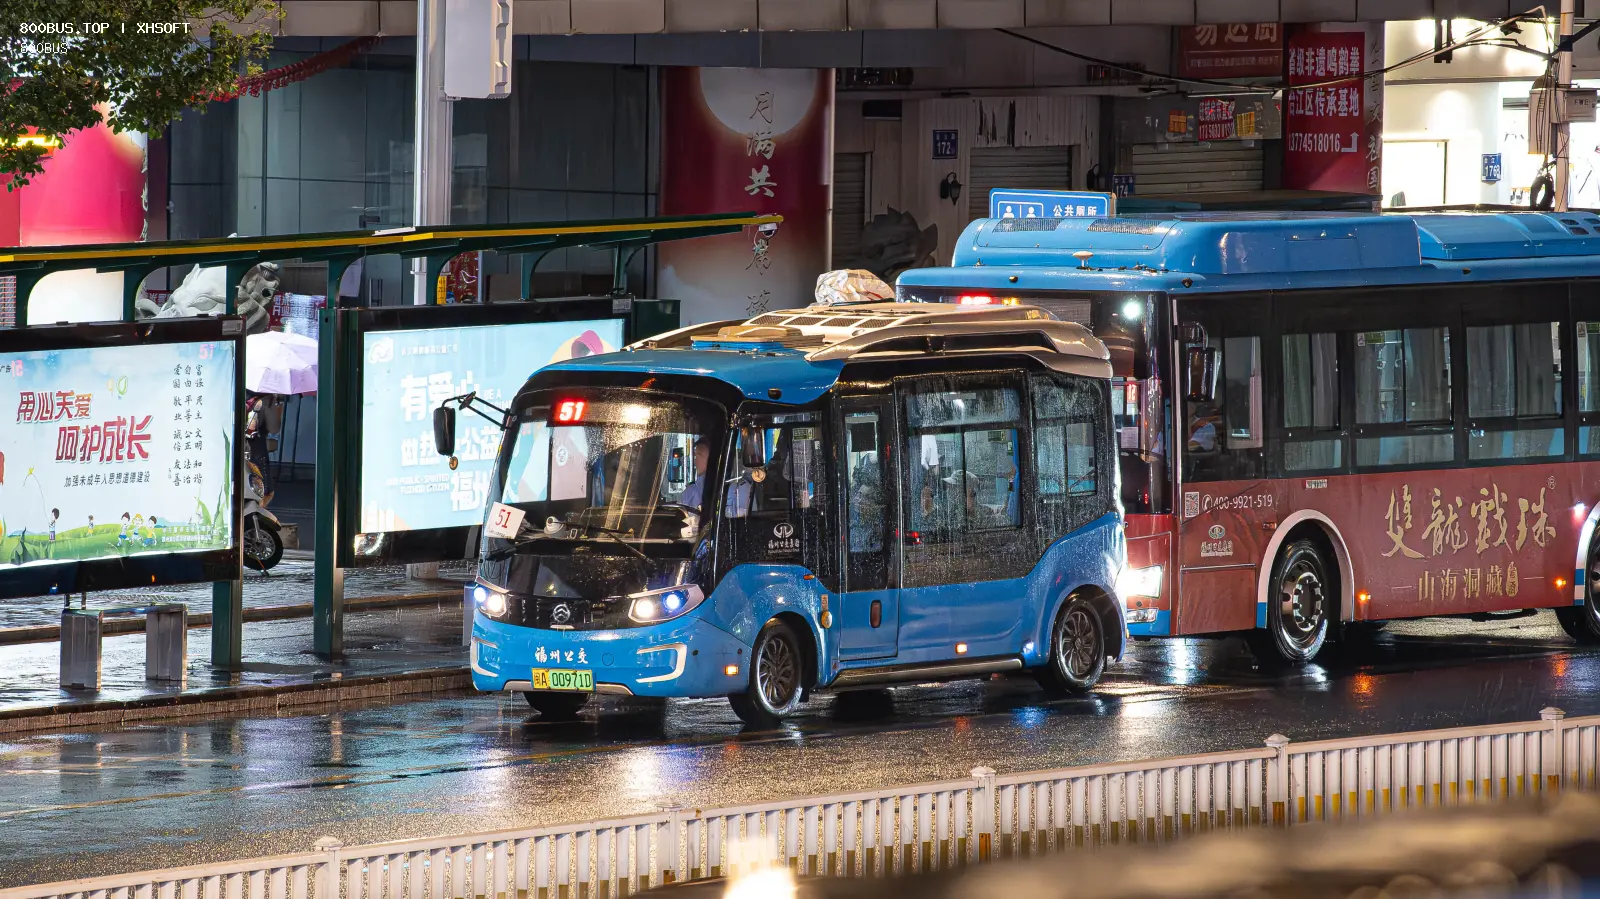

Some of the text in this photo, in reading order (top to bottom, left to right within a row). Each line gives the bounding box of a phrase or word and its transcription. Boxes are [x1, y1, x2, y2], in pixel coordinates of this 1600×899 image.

[1289, 88, 1359, 117] 台江区传承基地
[937, 141, 951, 155] 172
[1289, 132, 1340, 153] 13774518016
[1053, 204, 1097, 217] 公共厕所
[16, 389, 94, 424] 用心关爱
[559, 401, 585, 421] 51
[55, 414, 152, 464] 呵护成长
[64, 471, 151, 488] 加强未成年人思想道德建设
[1213, 494, 1273, 510] 400-9921-519
[495, 509, 512, 528] 51
[535, 645, 589, 664] 福州公交
